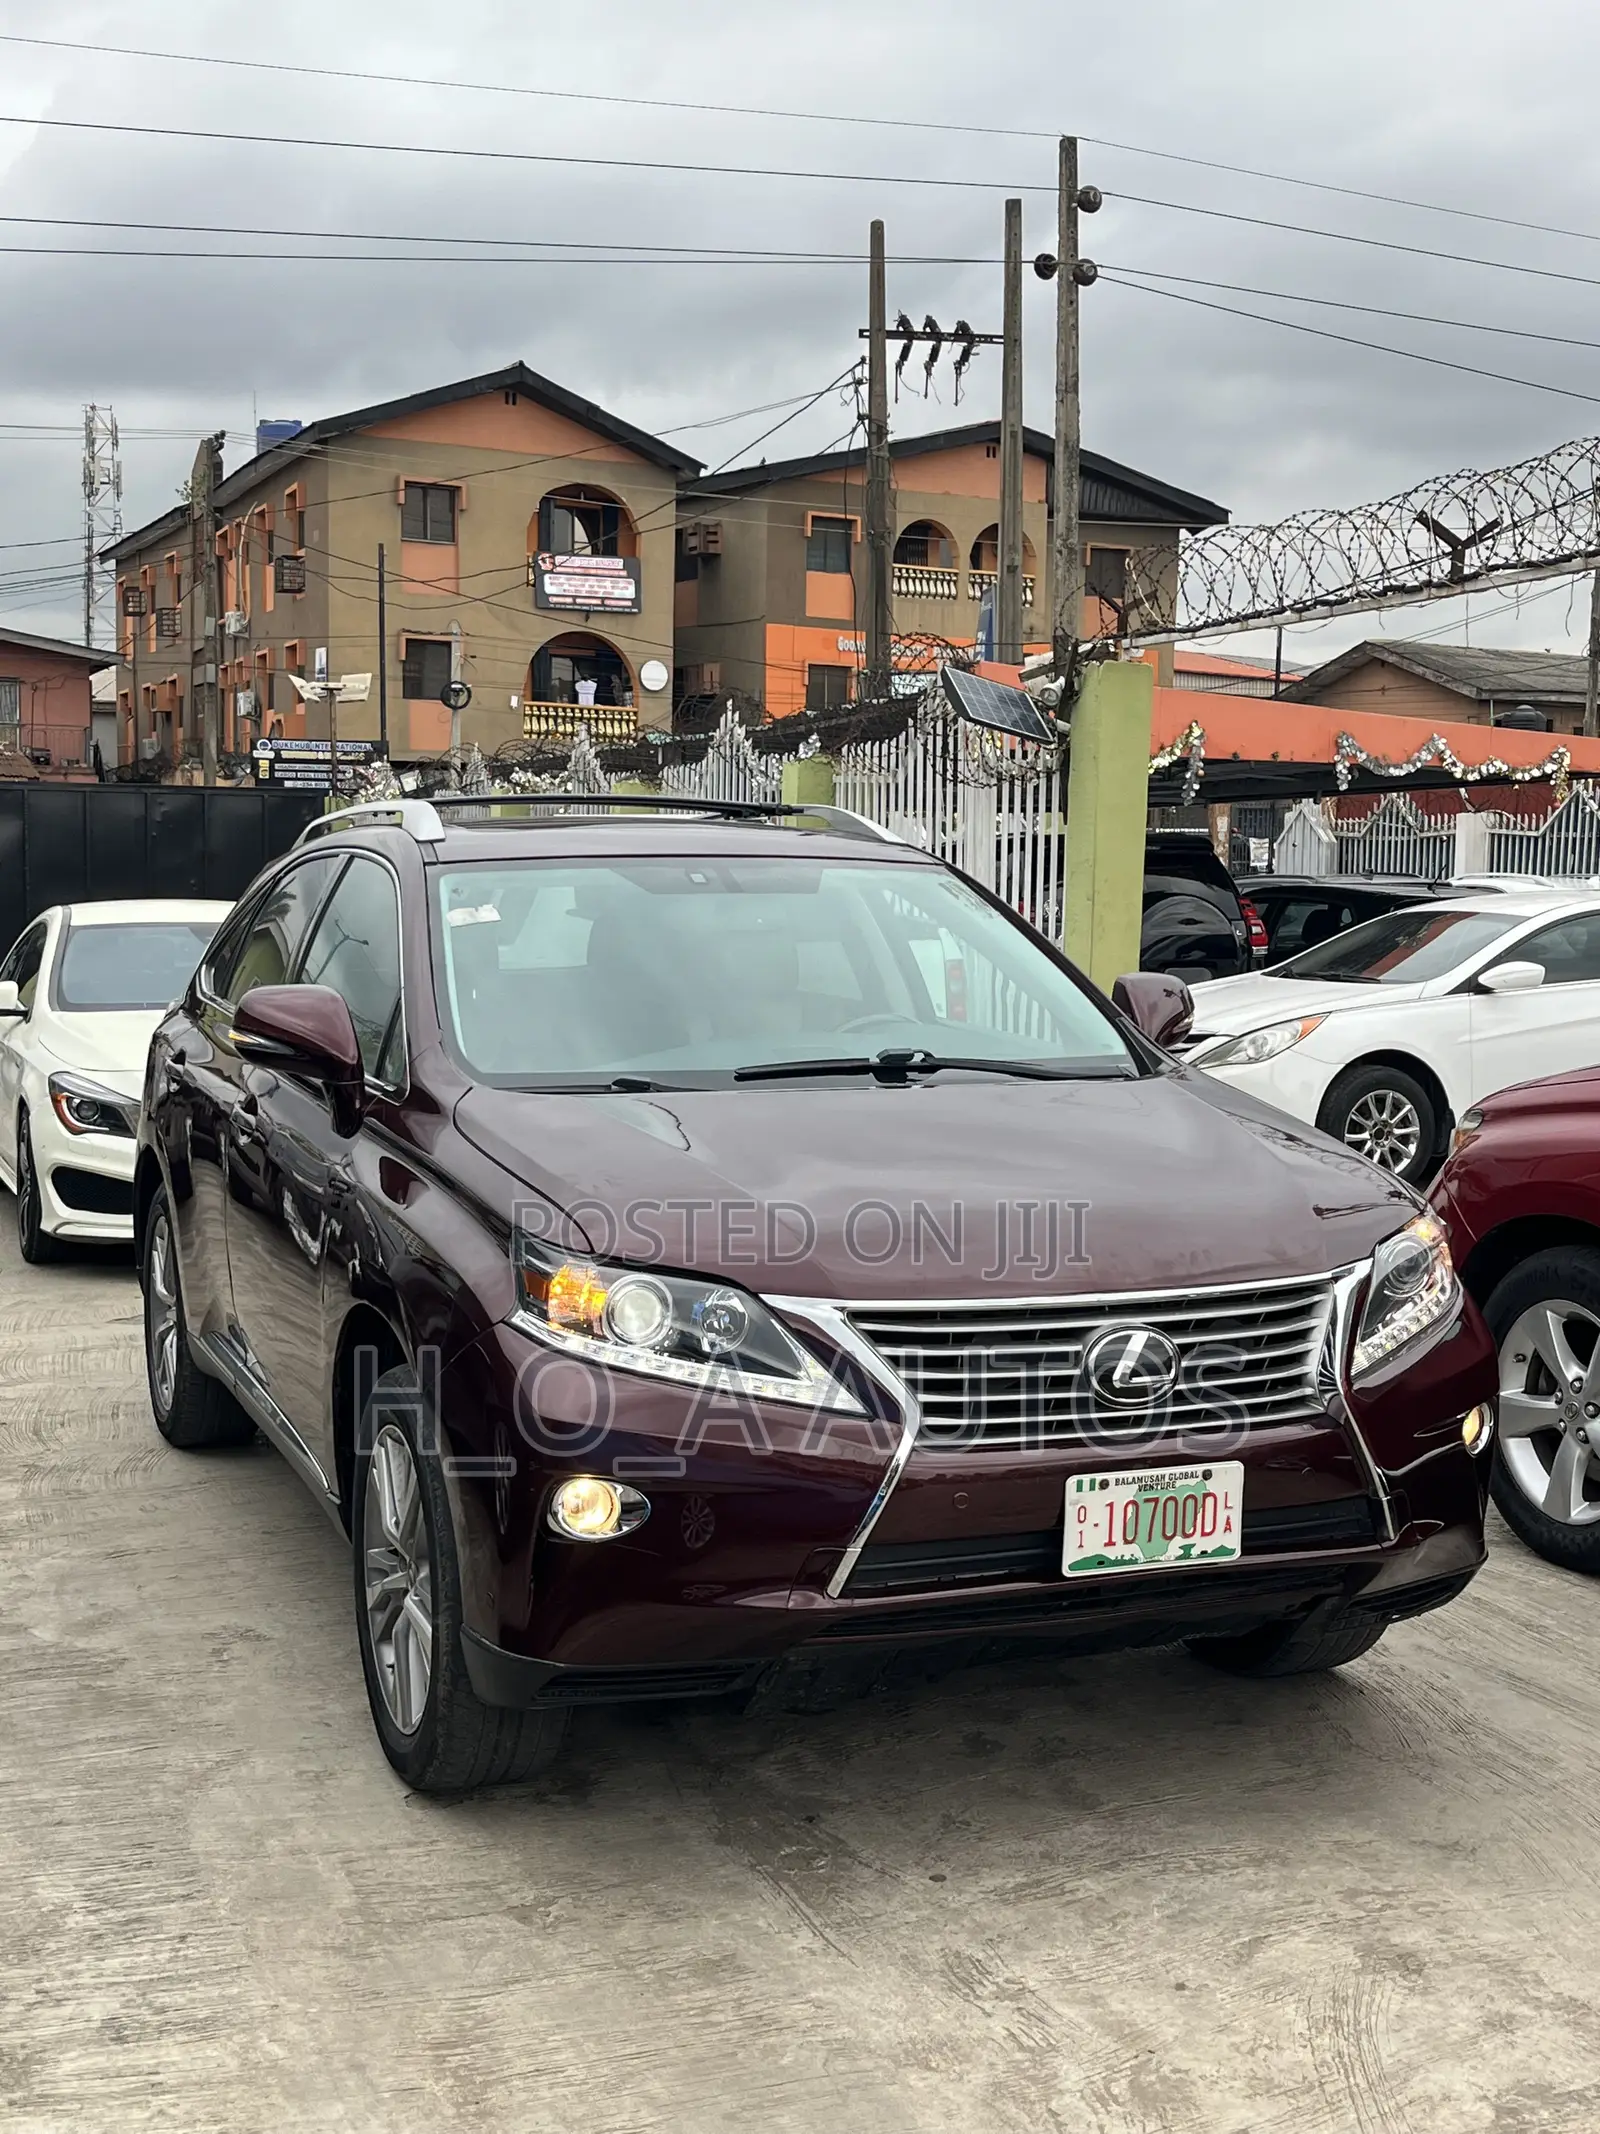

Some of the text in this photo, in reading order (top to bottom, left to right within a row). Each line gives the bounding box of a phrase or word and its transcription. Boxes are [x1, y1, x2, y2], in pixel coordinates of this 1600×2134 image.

[272, 740, 373, 752] DUKEHUB INTENATIONAL
[1114, 1471, 1200, 1487] BALAMUSAH GLOBAL
[1137, 1481, 1177, 1492] VENTURE
